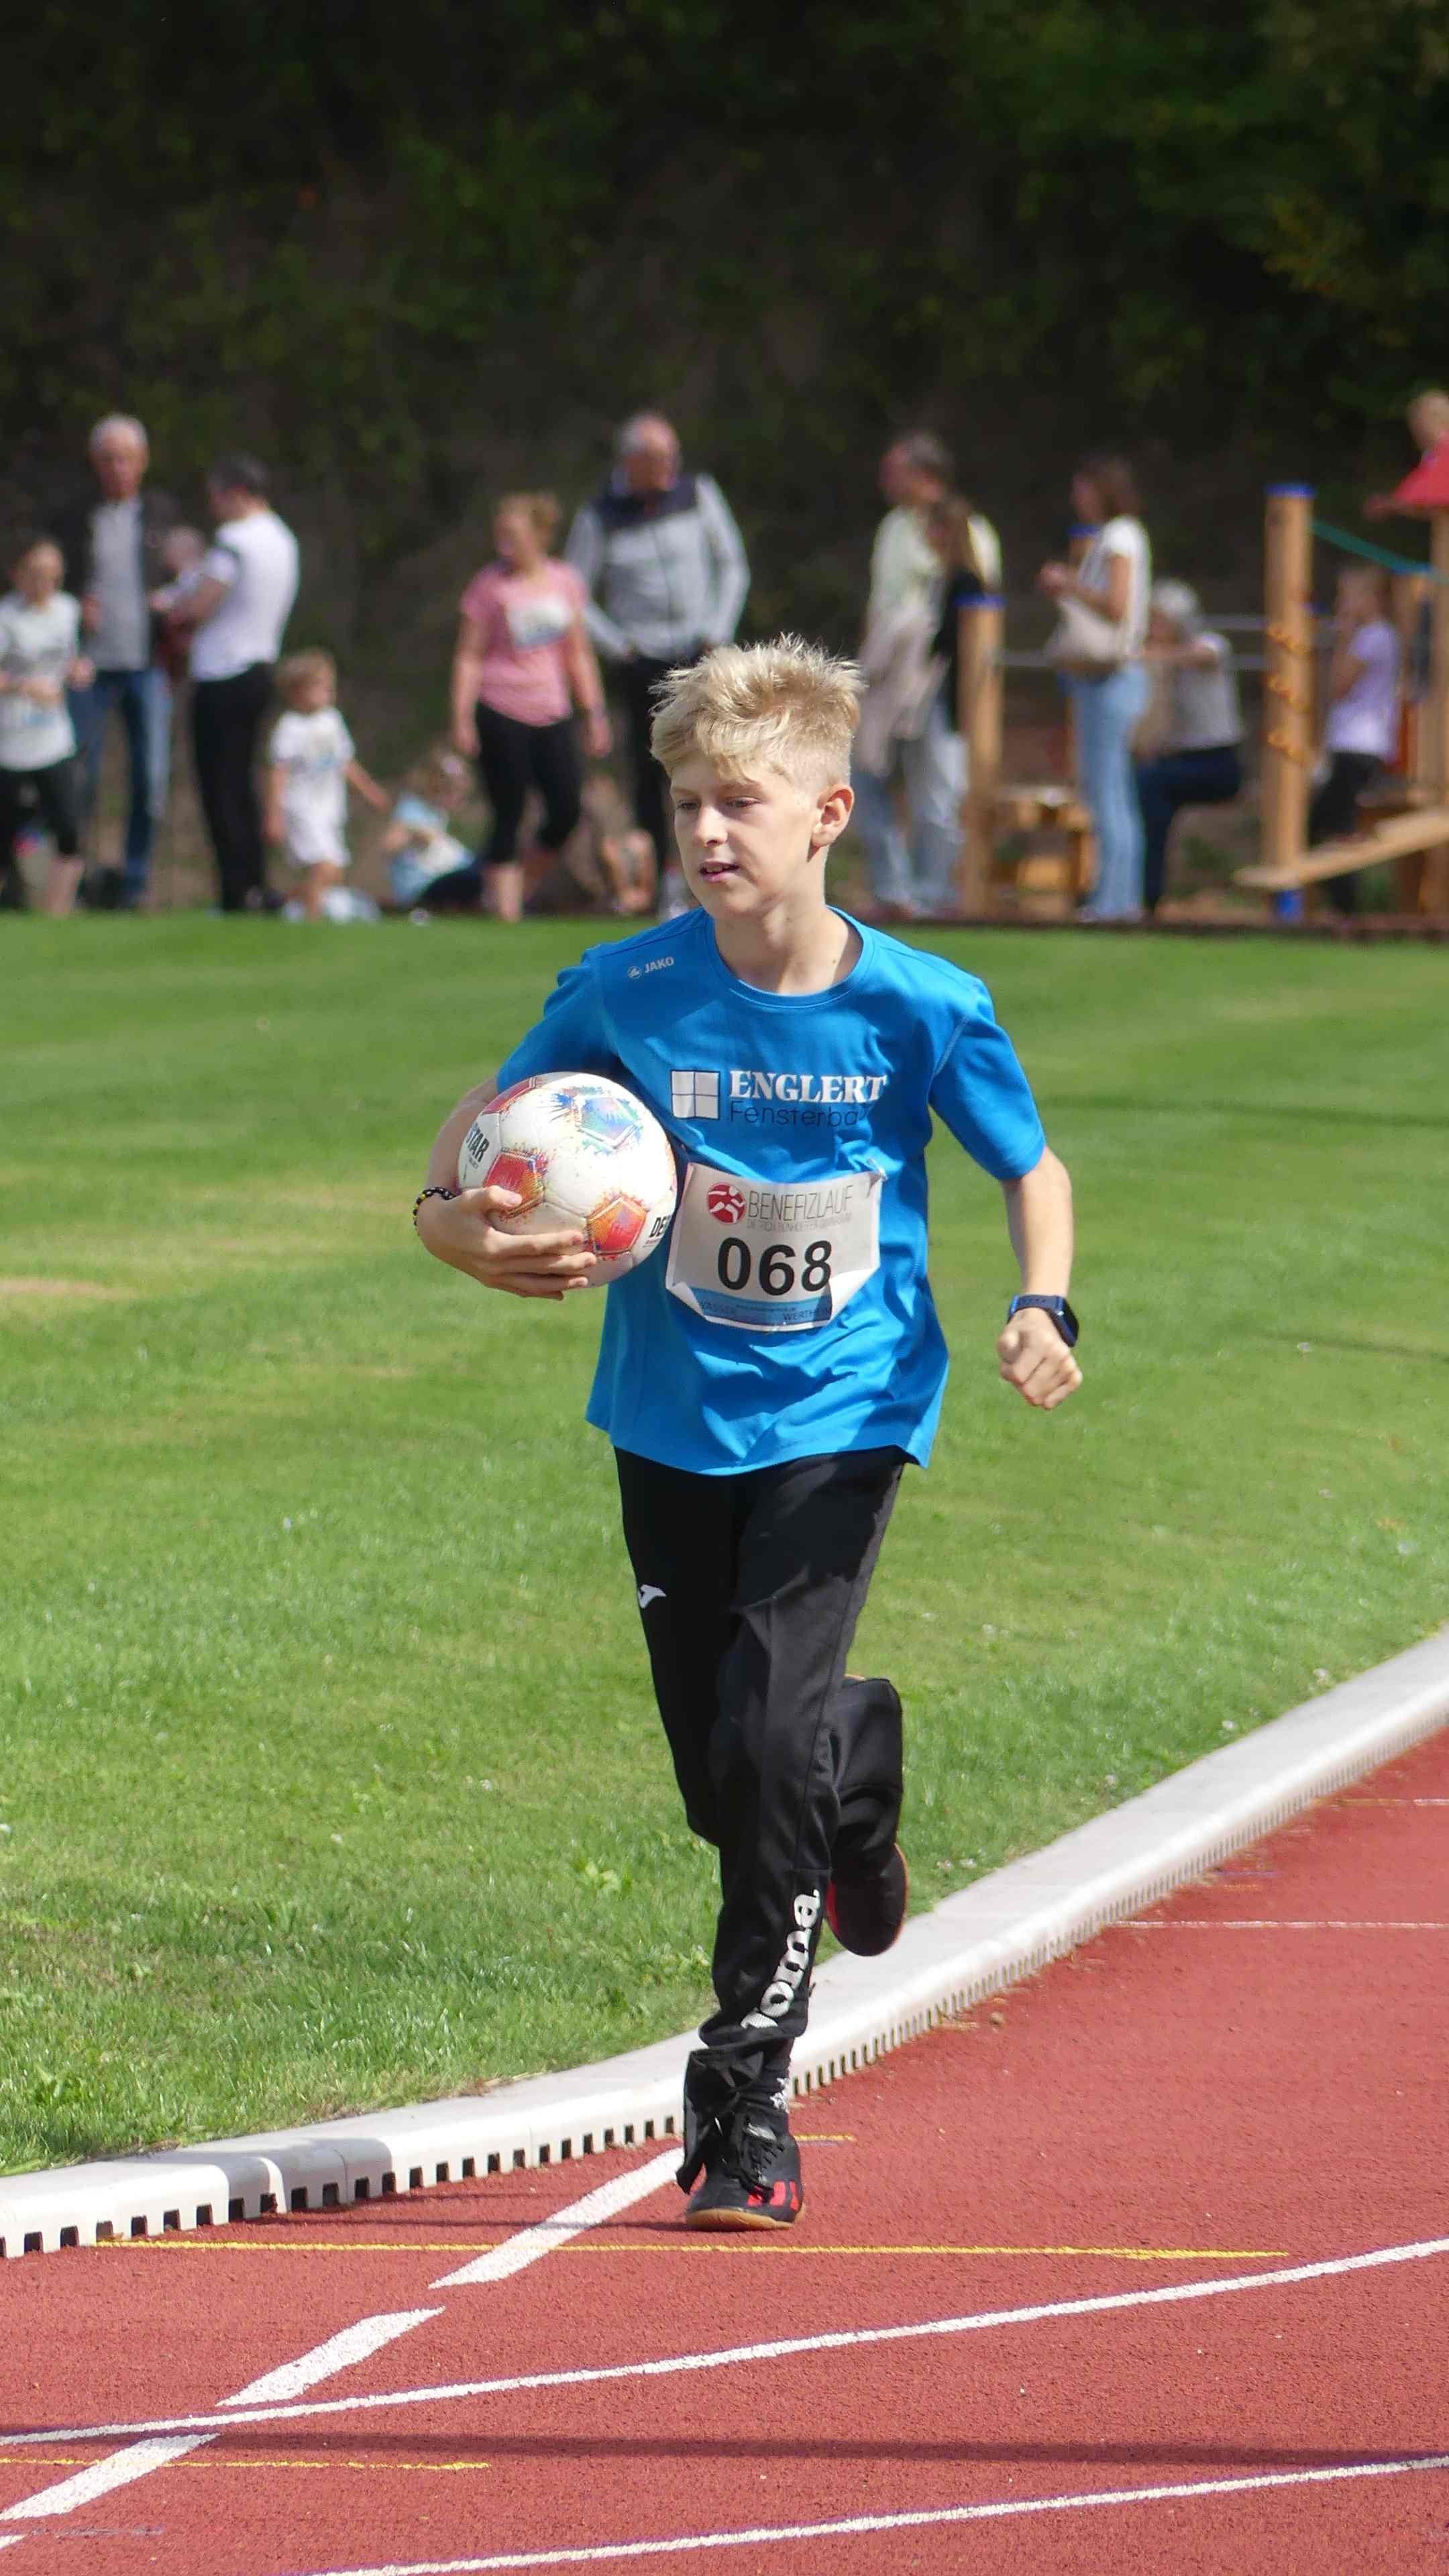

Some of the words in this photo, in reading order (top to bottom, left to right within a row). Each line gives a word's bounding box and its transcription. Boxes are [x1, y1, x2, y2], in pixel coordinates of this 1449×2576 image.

[645, 957, 674, 973] JAKO
[730, 1071, 887, 1104] ENGLERT
[730, 1102, 863, 1128] Fensterba
[748, 1185, 853, 1221] BENEFIZLAUF
[718, 1237, 832, 1295] 068
